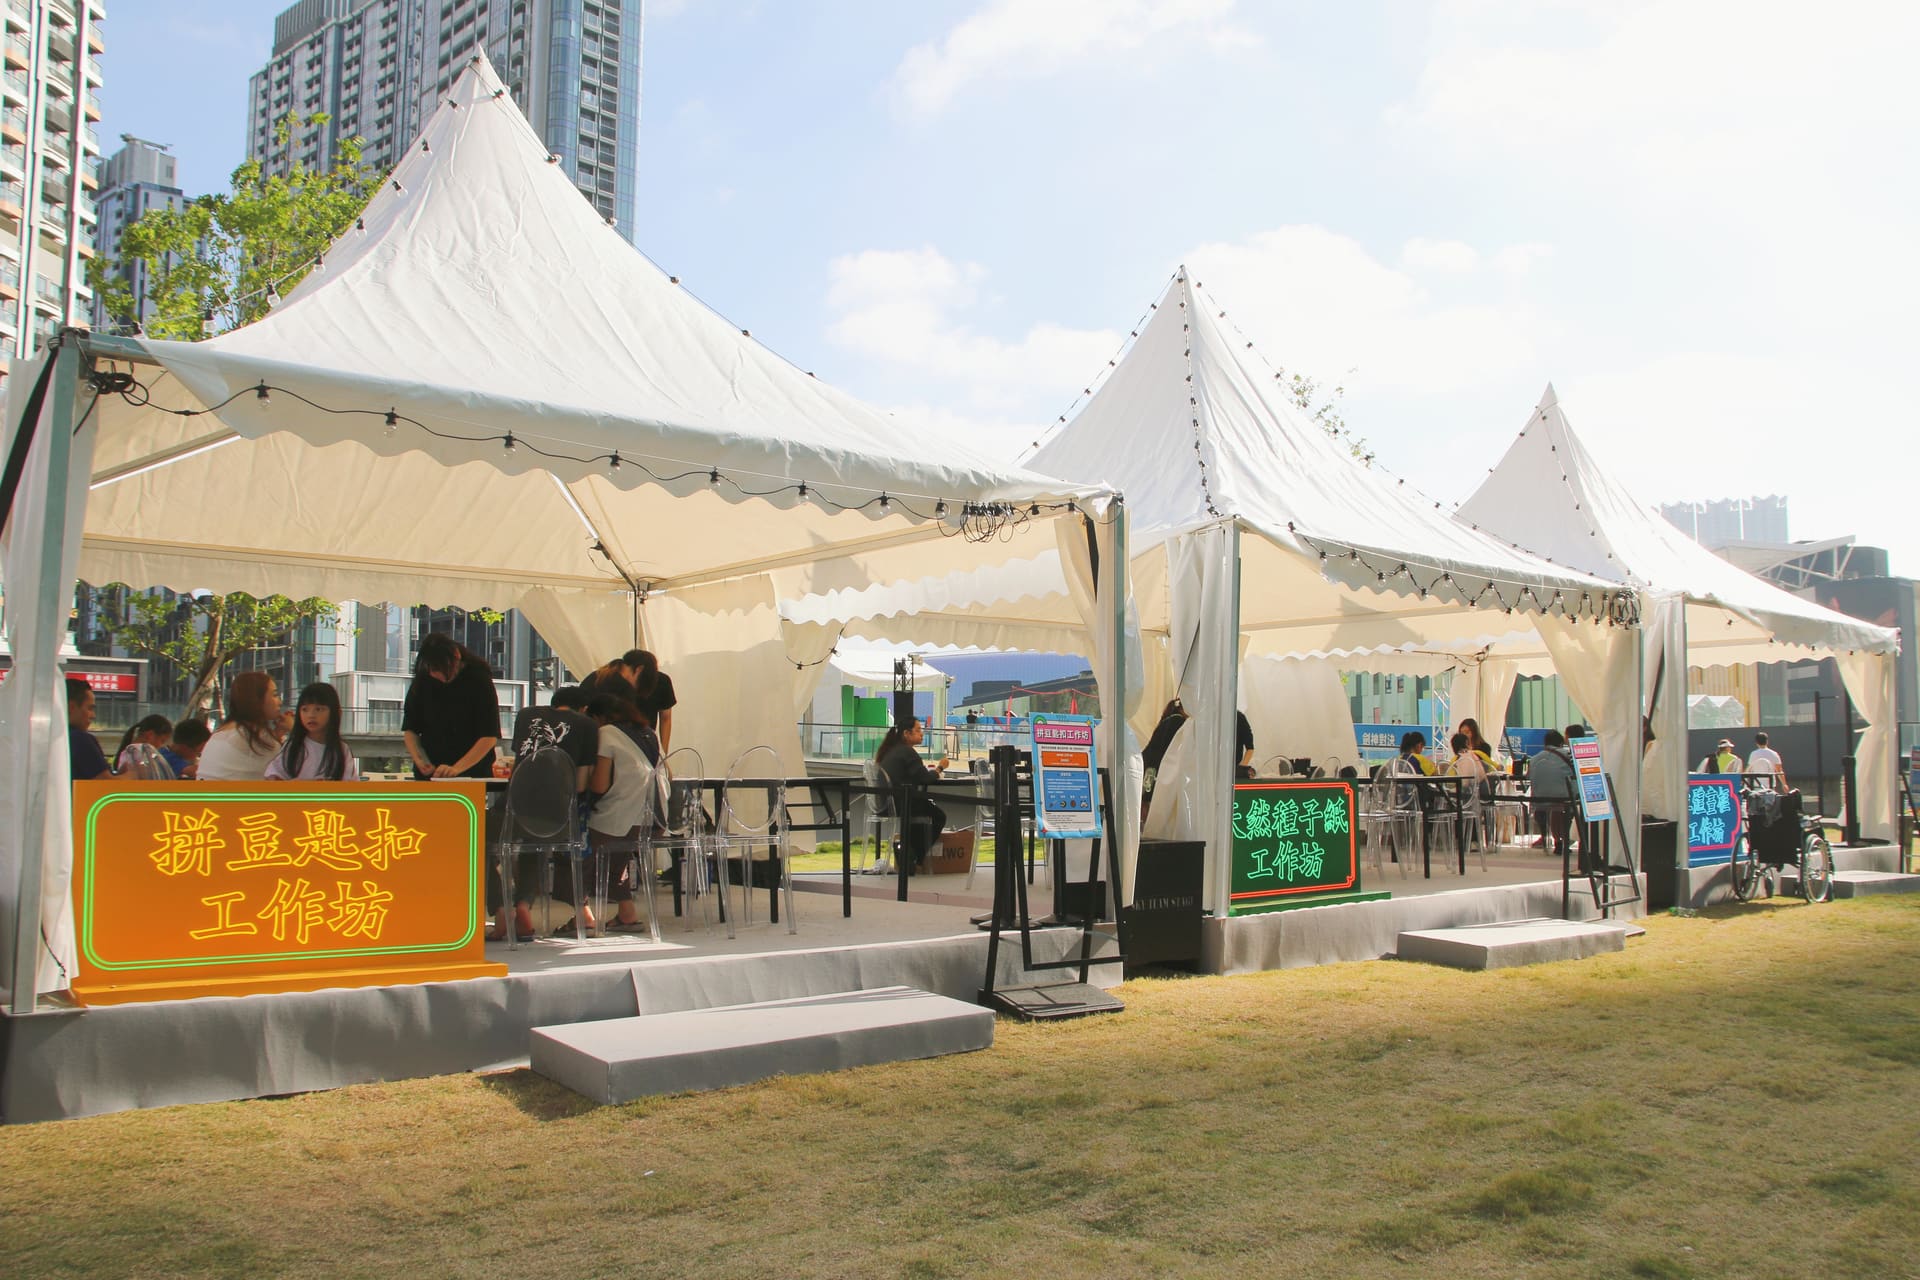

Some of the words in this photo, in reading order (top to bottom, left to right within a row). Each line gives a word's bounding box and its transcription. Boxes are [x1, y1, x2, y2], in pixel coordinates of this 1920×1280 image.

[1036, 727, 1090, 741] 拼豆匙扣工作坊
[148, 807, 428, 877] 拼豆匙扣
[1688, 816, 1726, 845] 工作坊
[1247, 840, 1325, 882] 工作坊
[188, 877, 394, 945] 工作坊
